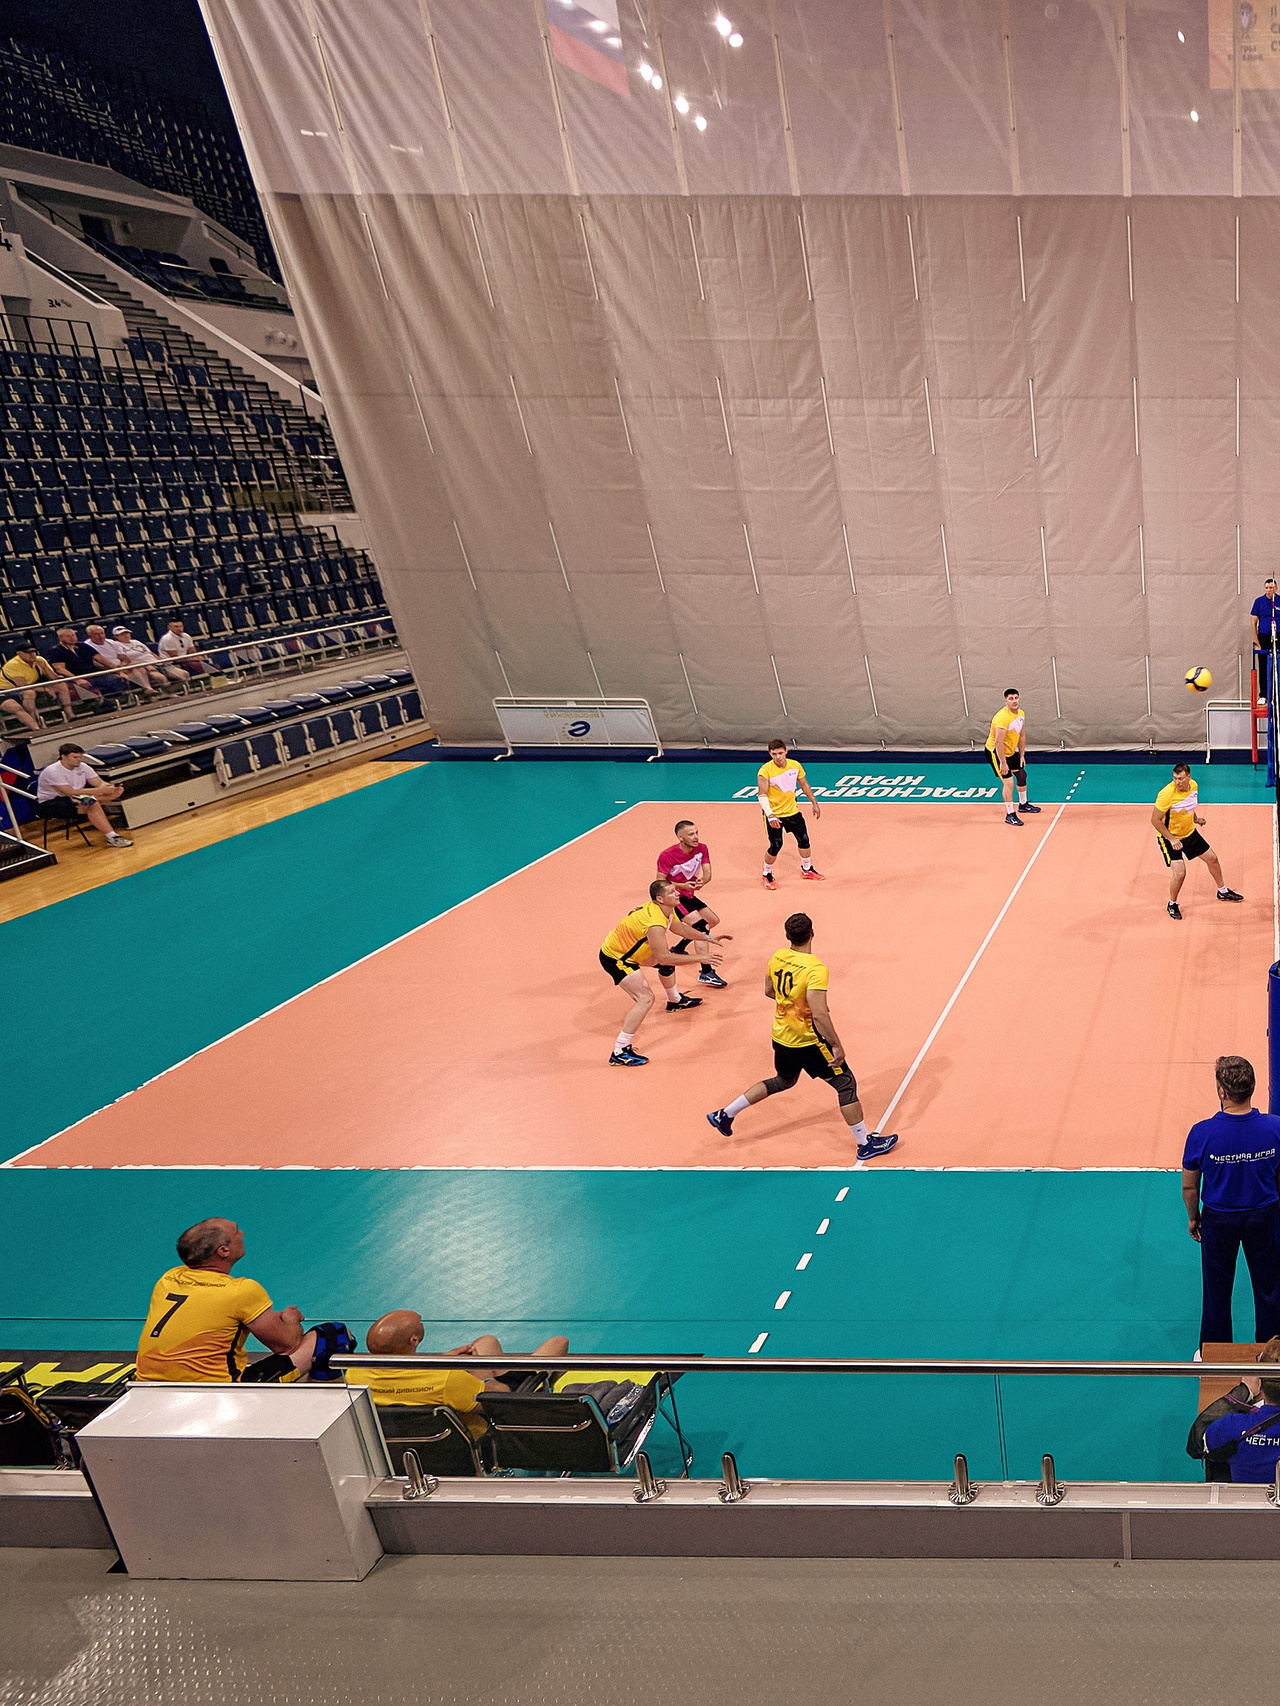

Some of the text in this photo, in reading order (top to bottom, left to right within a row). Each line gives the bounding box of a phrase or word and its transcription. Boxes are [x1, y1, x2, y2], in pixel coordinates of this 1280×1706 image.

[835, 775, 926, 787] КРАЙ
[732, 786, 998, 799] КРАСНОЯРСЙ
[774, 969, 793, 998] 10
[1215, 1153, 1252, 1161] ЧЕСТНАЯ
[1255, 1148, 1275, 1158] ИГРА
[150, 1292, 189, 1338] 7
